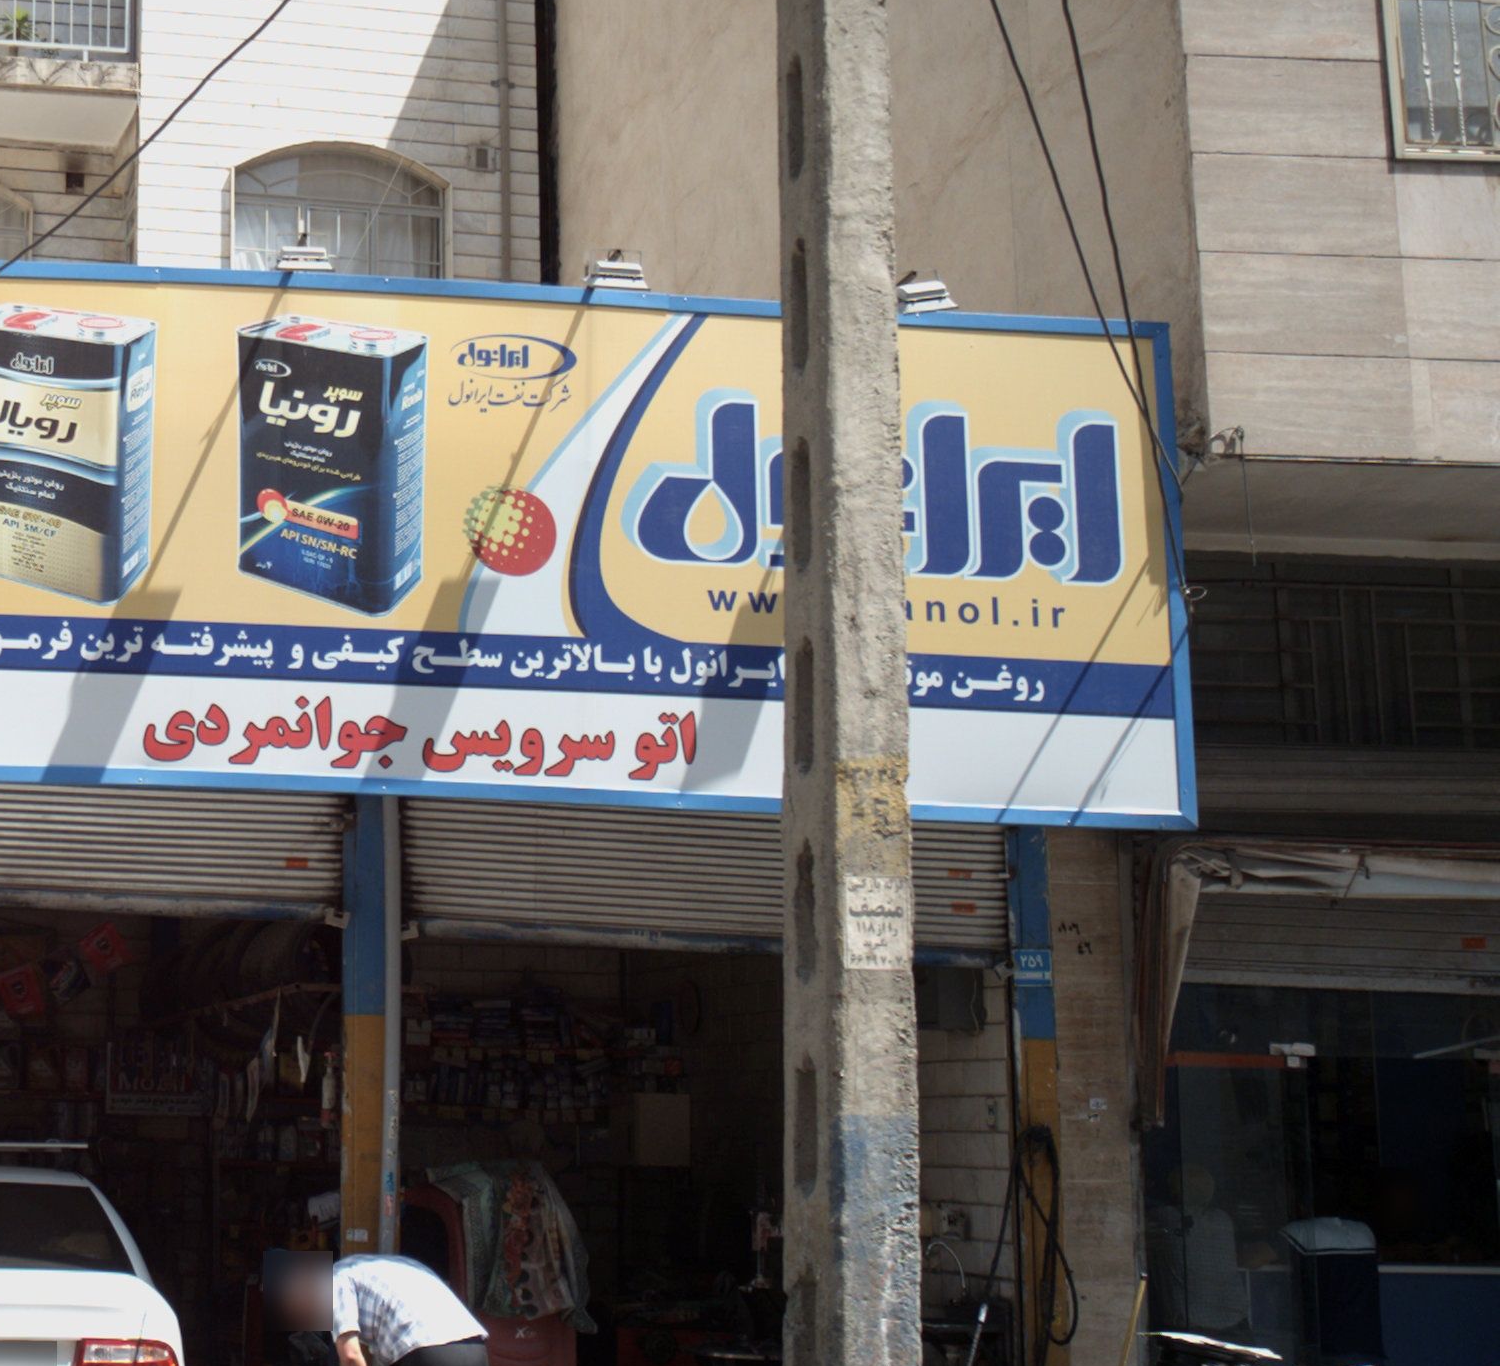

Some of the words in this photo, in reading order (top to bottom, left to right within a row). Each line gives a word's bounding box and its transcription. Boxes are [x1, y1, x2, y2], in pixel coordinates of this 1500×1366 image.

[457, 342, 529, 368] ایرانول
[40, 393, 82, 411] سوپر
[258, 381, 361, 438] رونیا
[323, 385, 364, 403] سوپر
[448, 379, 492, 413] ایرانول
[488, 381, 524, 406] نفت
[522, 373, 572, 412] شرکت
[634, 399, 1124, 585] ایرال
[292, 508, 313, 521] SAE
[280, 528, 300, 542] API
[80, 626, 145, 662] ترین
[151, 625, 274, 669] پیشرفته
[288, 644, 305, 671] و
[312, 635, 404, 671] کیفی
[412, 638, 503, 674] سطح
[510, 643, 636, 681] بالاترین
[644, 646, 663, 683] با
[670, 647, 785, 688] ایرانول
[951, 664, 1045, 702] روغن
[143, 695, 408, 769] جوانمردی
[422, 719, 616, 777] سرویس
[629, 709, 697, 781] اتو
[849, 897, 904, 918] منصف
[856, 921, 875, 933] ۱۱۸
[1020, 954, 1043, 968] ۲۵۹
